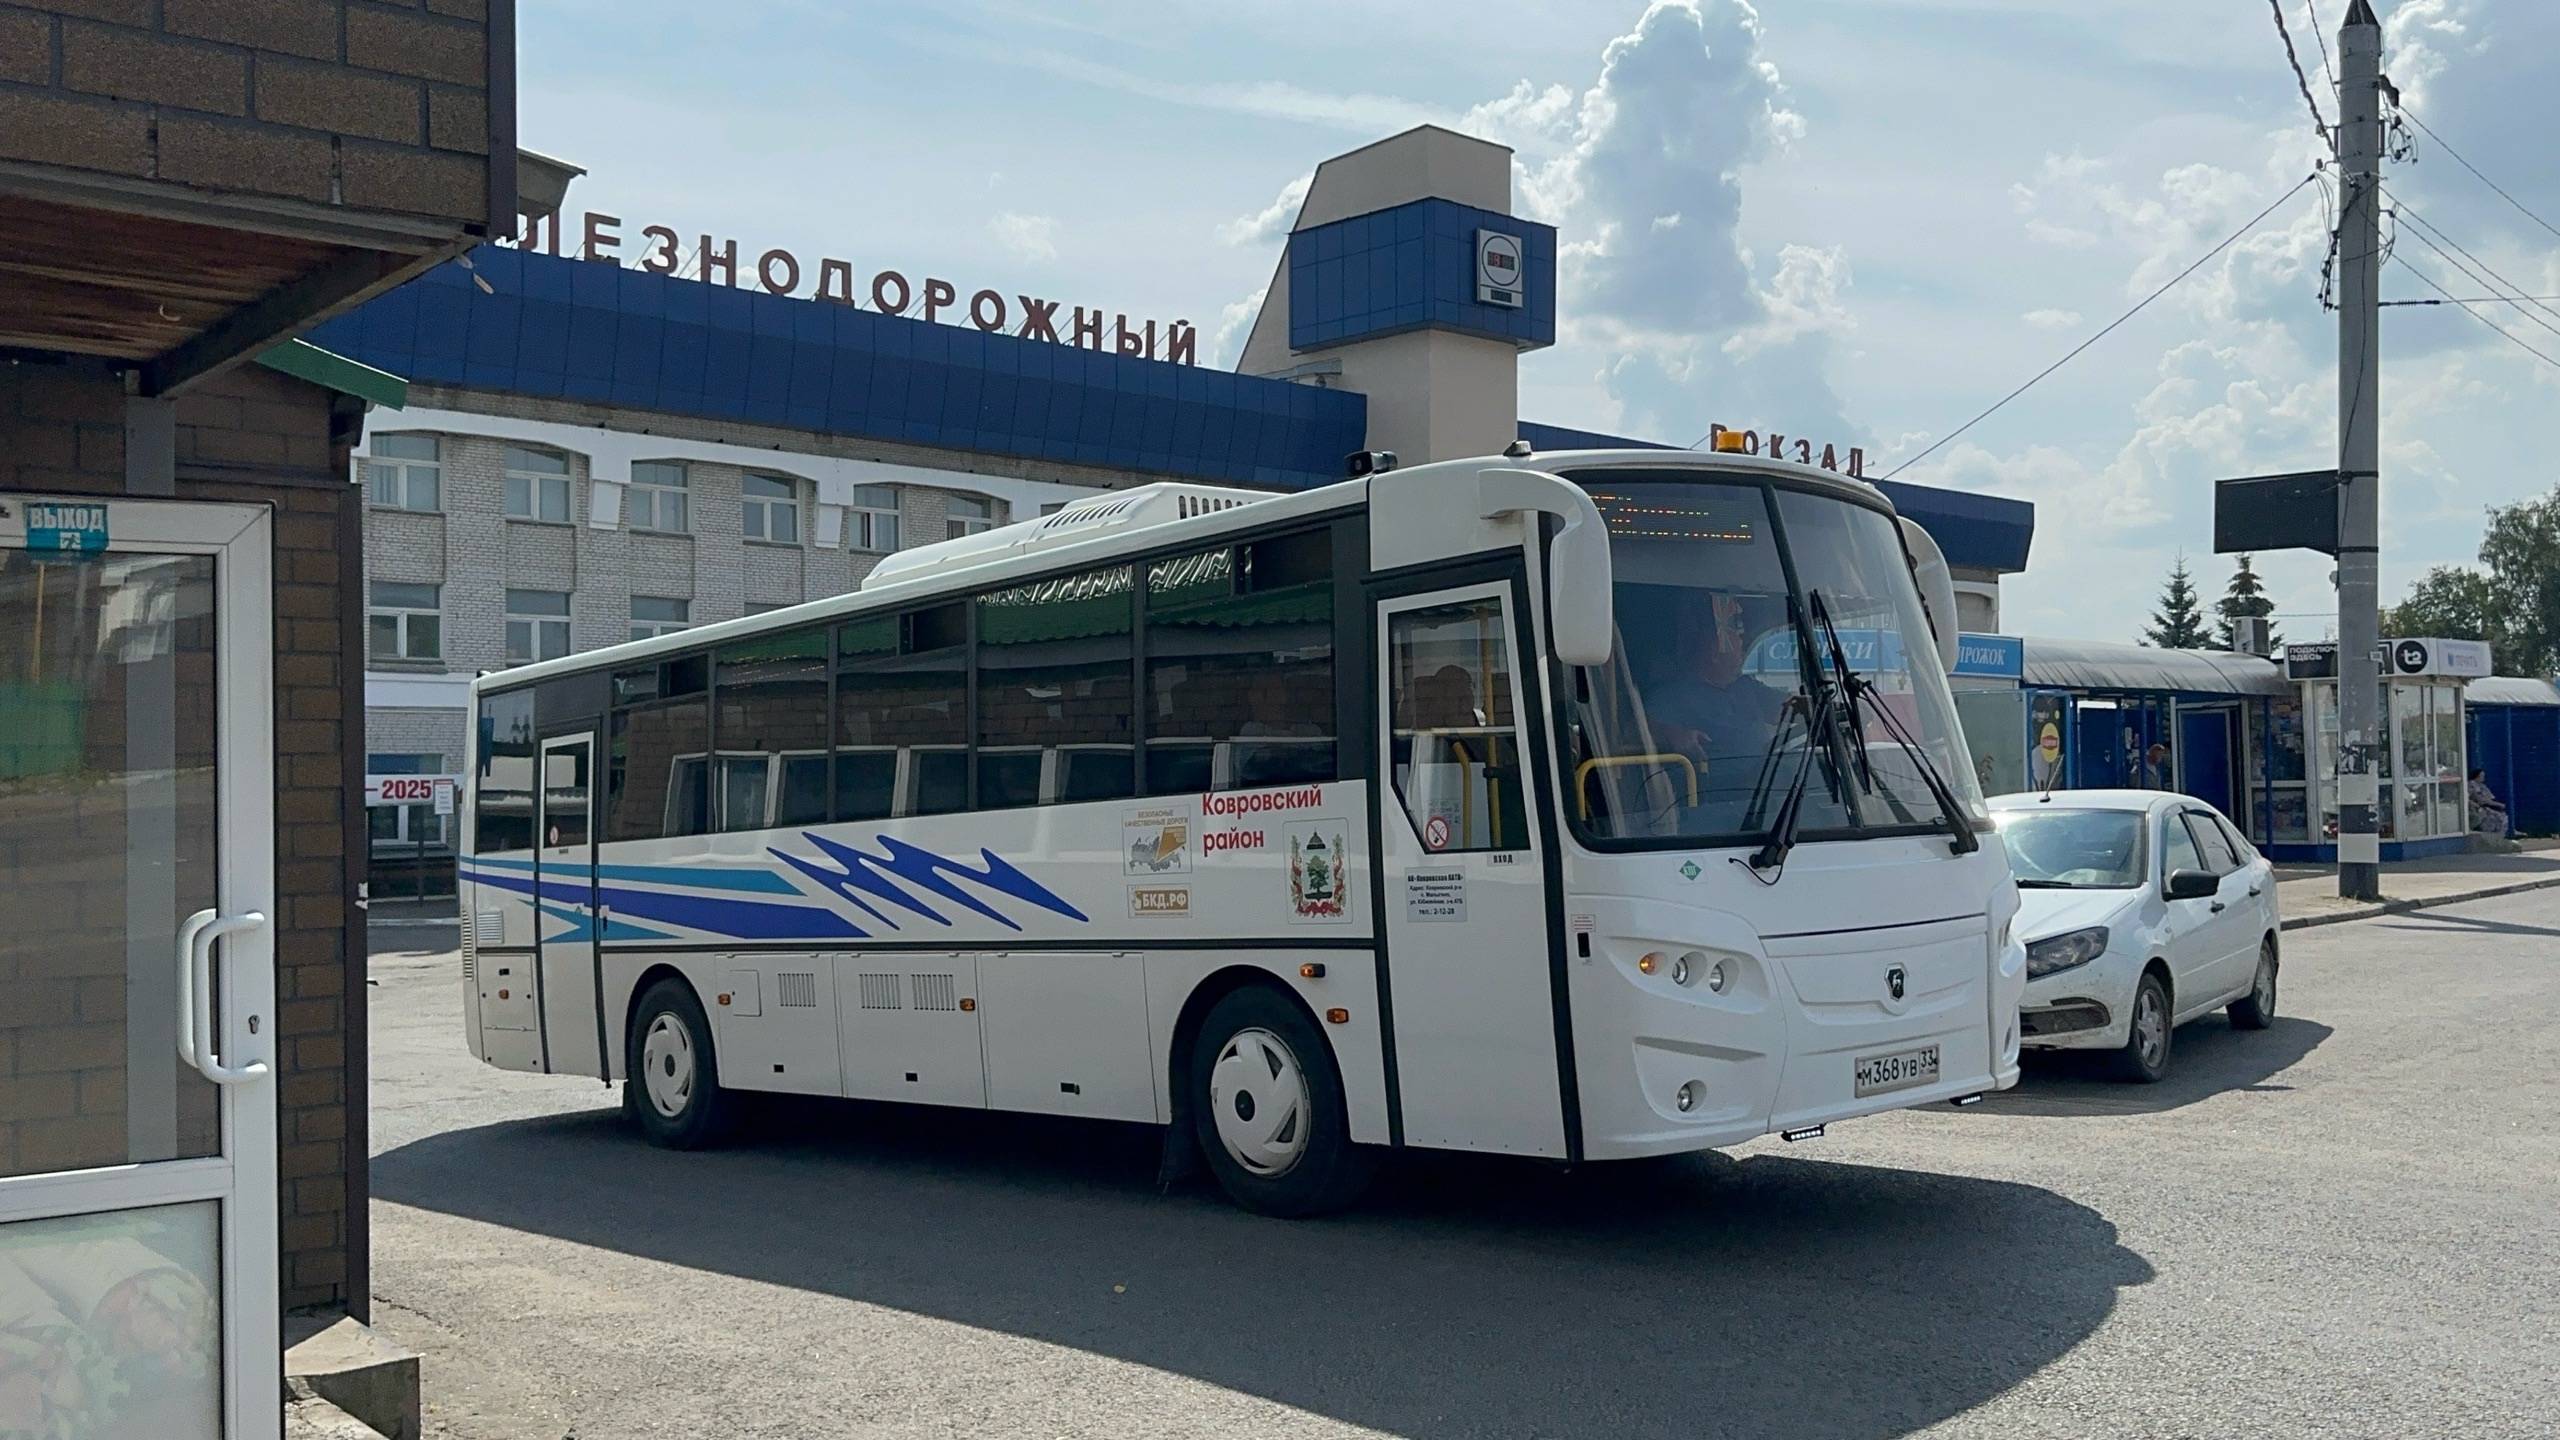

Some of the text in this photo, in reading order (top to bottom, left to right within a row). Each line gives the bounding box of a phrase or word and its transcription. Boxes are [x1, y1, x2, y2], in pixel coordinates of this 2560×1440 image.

[30, 507, 105, 533] ВЫХОД
[382, 779, 432, 799] 2025
[1202, 783, 1322, 820] Ковровский
[1203, 826, 1265, 858] район
[1141, 892, 1186, 910] БКД.РФ
